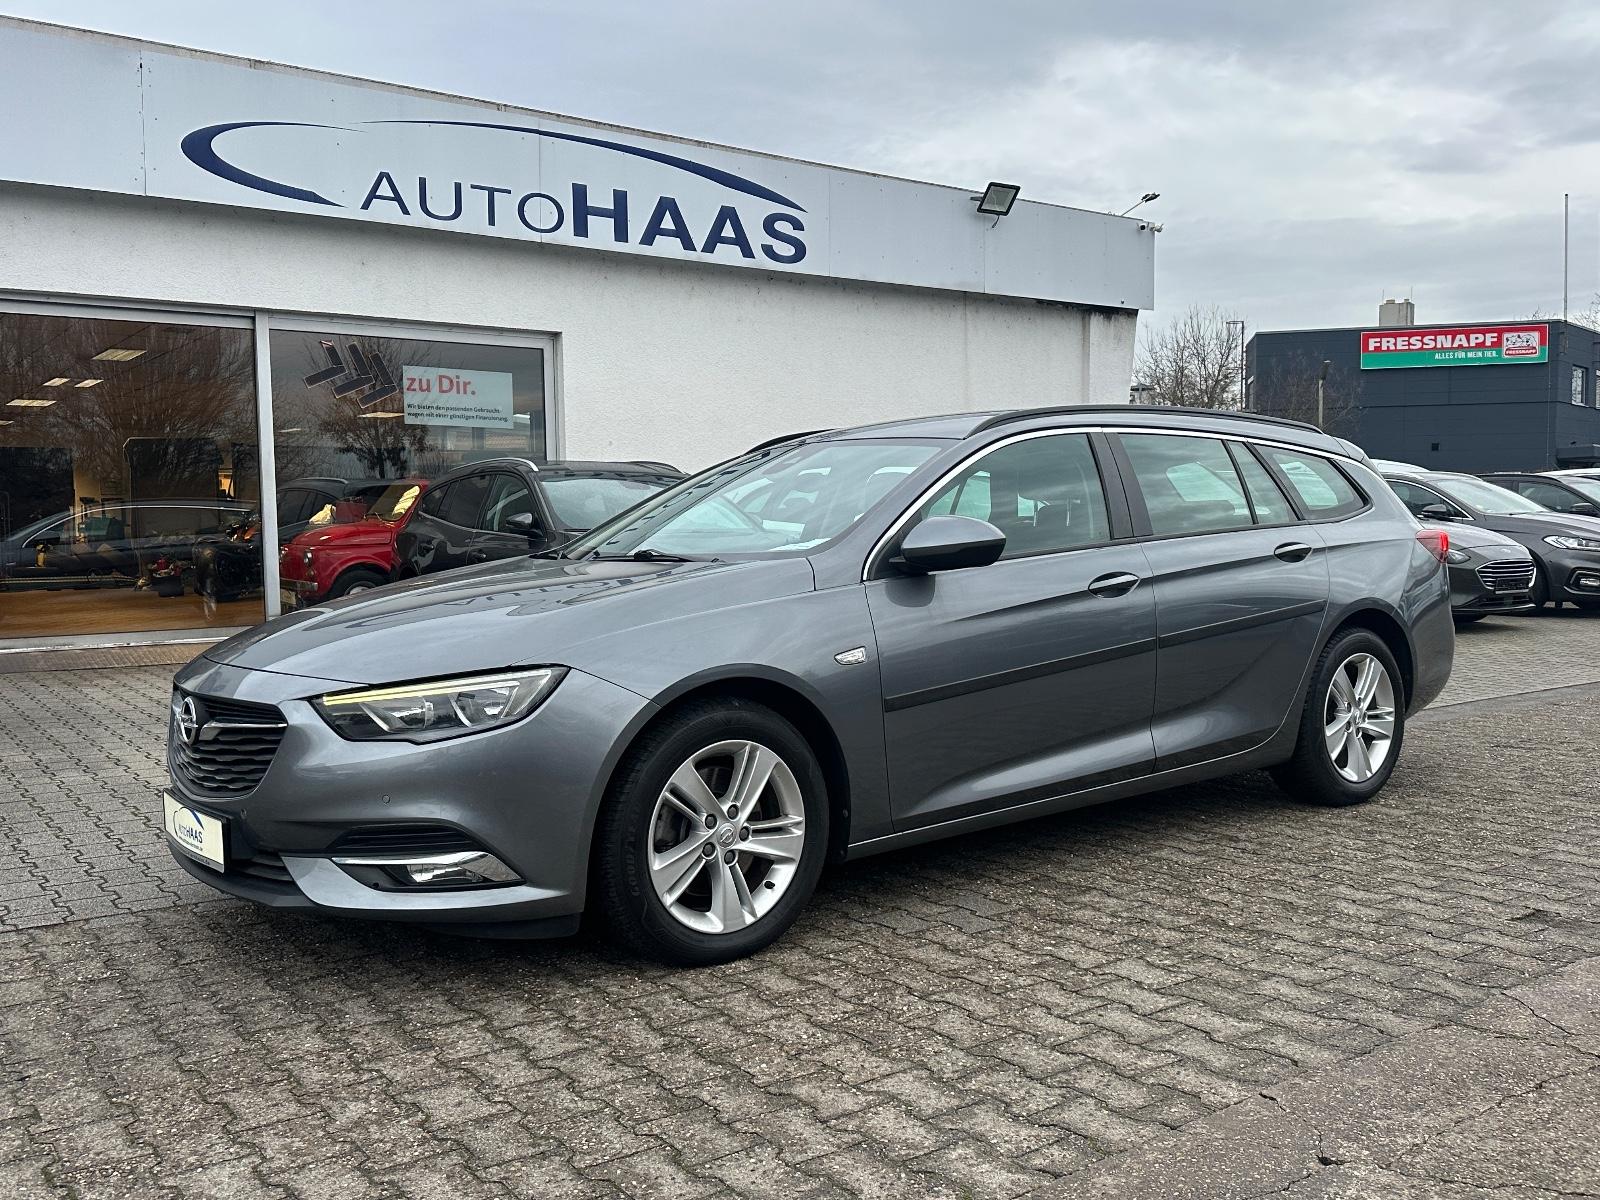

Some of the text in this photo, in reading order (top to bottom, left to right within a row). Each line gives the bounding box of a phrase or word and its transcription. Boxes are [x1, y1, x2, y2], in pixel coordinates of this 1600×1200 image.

[1368, 332, 1498, 351] FRESSNAPF
[1435, 350, 1499, 360] ALLES FÜR MEIN TIER.
[406, 374, 476, 396] zu Dir.
